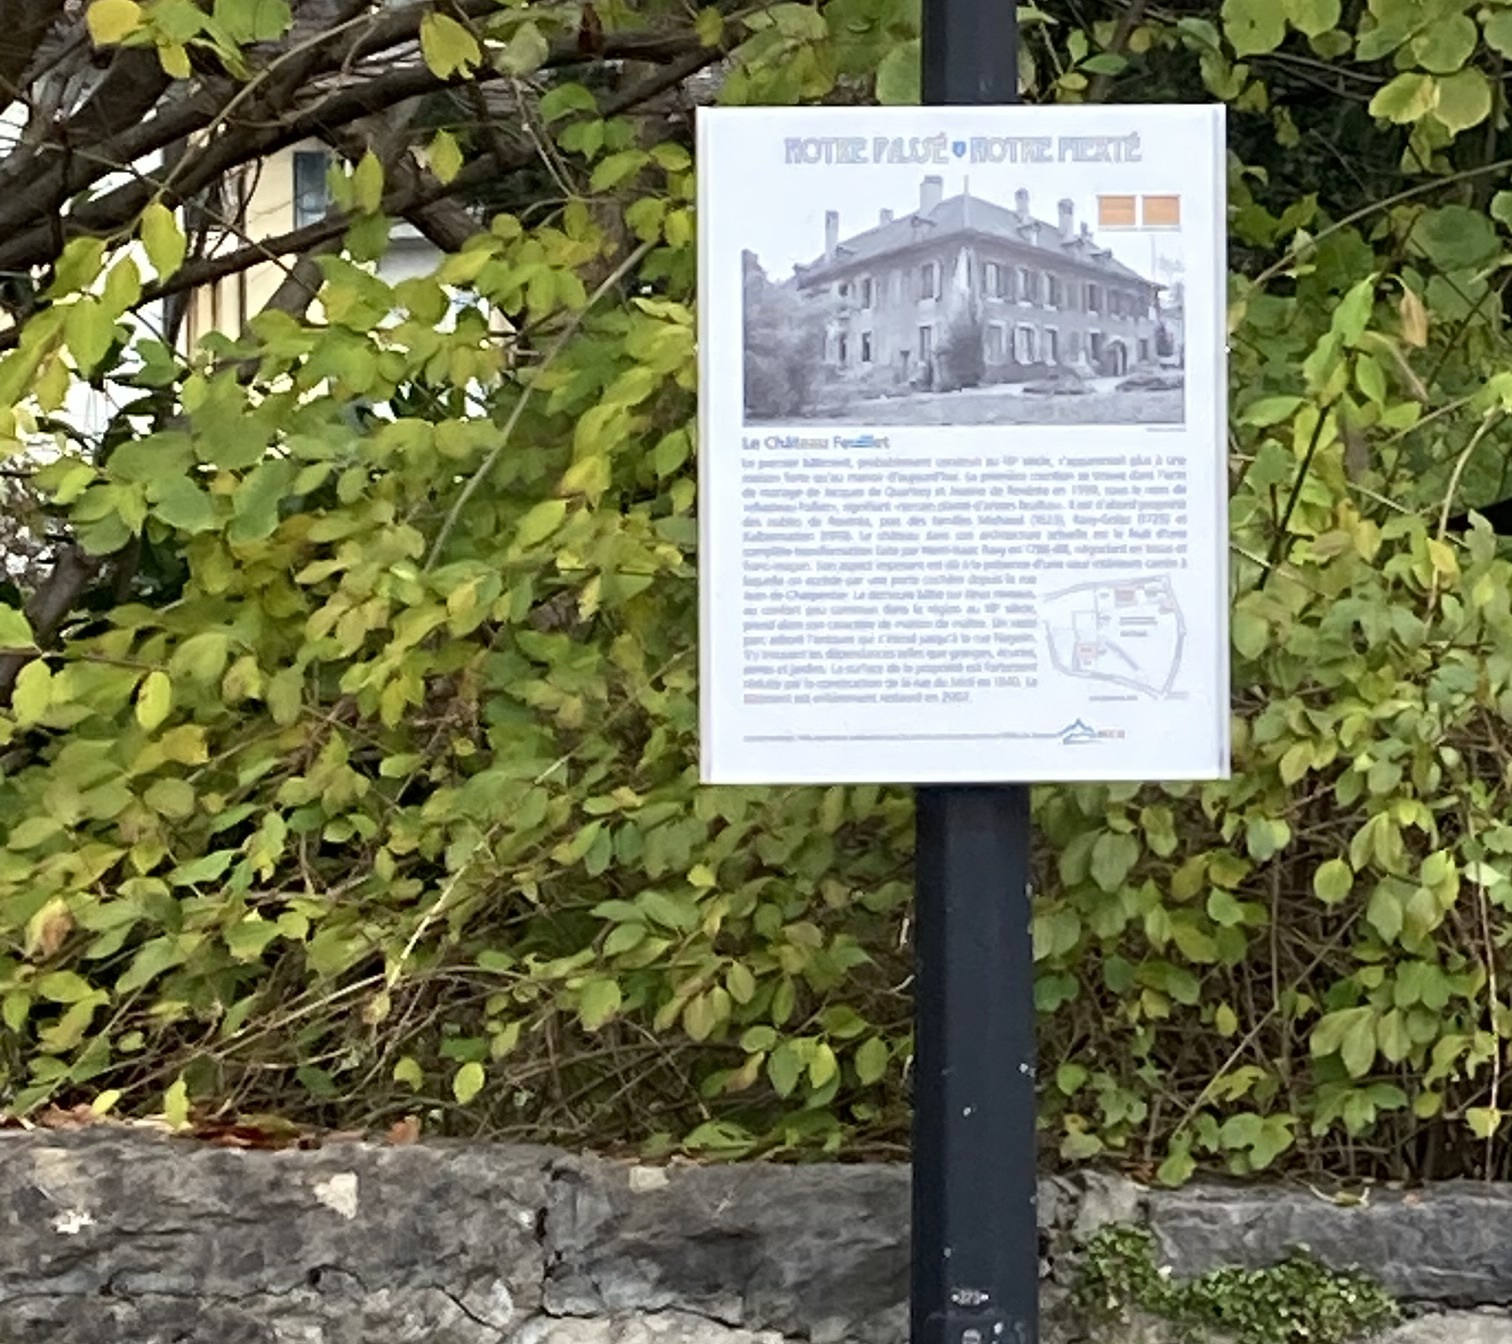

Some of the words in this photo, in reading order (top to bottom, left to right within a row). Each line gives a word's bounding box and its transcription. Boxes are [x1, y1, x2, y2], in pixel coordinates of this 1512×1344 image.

[784, 136, 868, 164] NOTRE
[873, 131, 949, 164] PASSÉ
[970, 136, 1053, 163] NOTRE
[742, 436, 760, 450] Le
